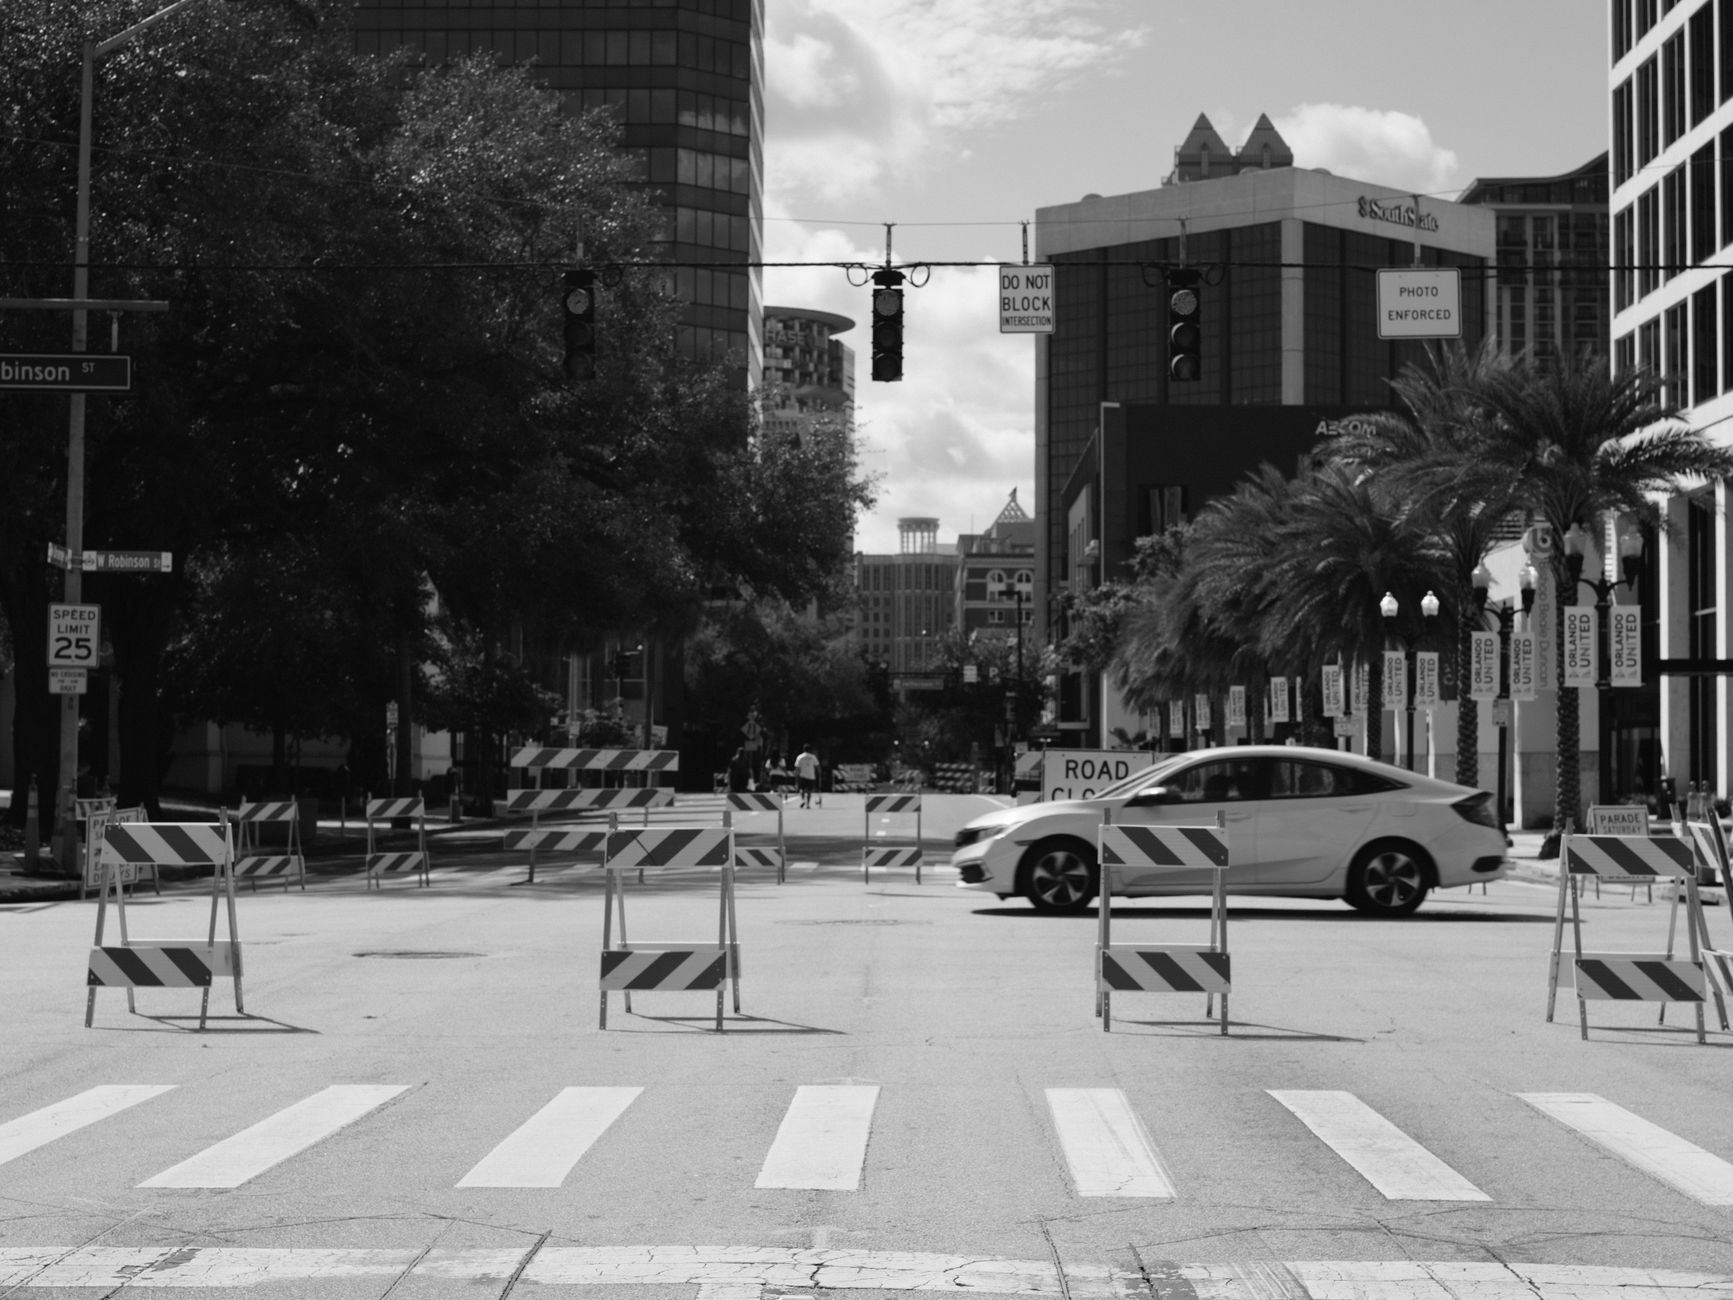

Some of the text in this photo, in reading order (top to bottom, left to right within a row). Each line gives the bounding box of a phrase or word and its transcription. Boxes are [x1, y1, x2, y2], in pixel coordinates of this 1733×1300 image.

[1369, 199, 1439, 232] SouthSate
[1002, 275, 1050, 290] DO NOT
[1399, 286, 1439, 297] PHOTO
[1002, 296, 1051, 311] BLOCK
[1002, 316, 1051, 326] INTERSECTION
[1388, 309, 1451, 321] ENFORCED
[81, 362, 96, 373] ST
[97, 554, 105, 567] W
[108, 553, 150, 568] Robinson
[53, 609, 96, 621] SPEED
[57, 624, 90, 634] LIMIT
[54, 637, 92, 660] 25
[1568, 614, 1577, 668] ORLANDO
[1579, 614, 1591, 668] UNITED
[1615, 614, 1624, 668] ORLANDO
[1626, 614, 1637, 668] UNITED
[1474, 638, 1482, 684] ORLANDO
[1484, 638, 1493, 684] UNITED
[1513, 639, 1521, 684] ORLANDO
[1522, 639, 1532, 685] UNITED
[1394, 657, 1402, 697] UNITED
[1426, 658, 1435, 697] UNITED
[1065, 759, 1129, 780] ROAD
[1600, 814, 1640, 824] PARADE
[1603, 825, 1640, 834] SATURDAY
